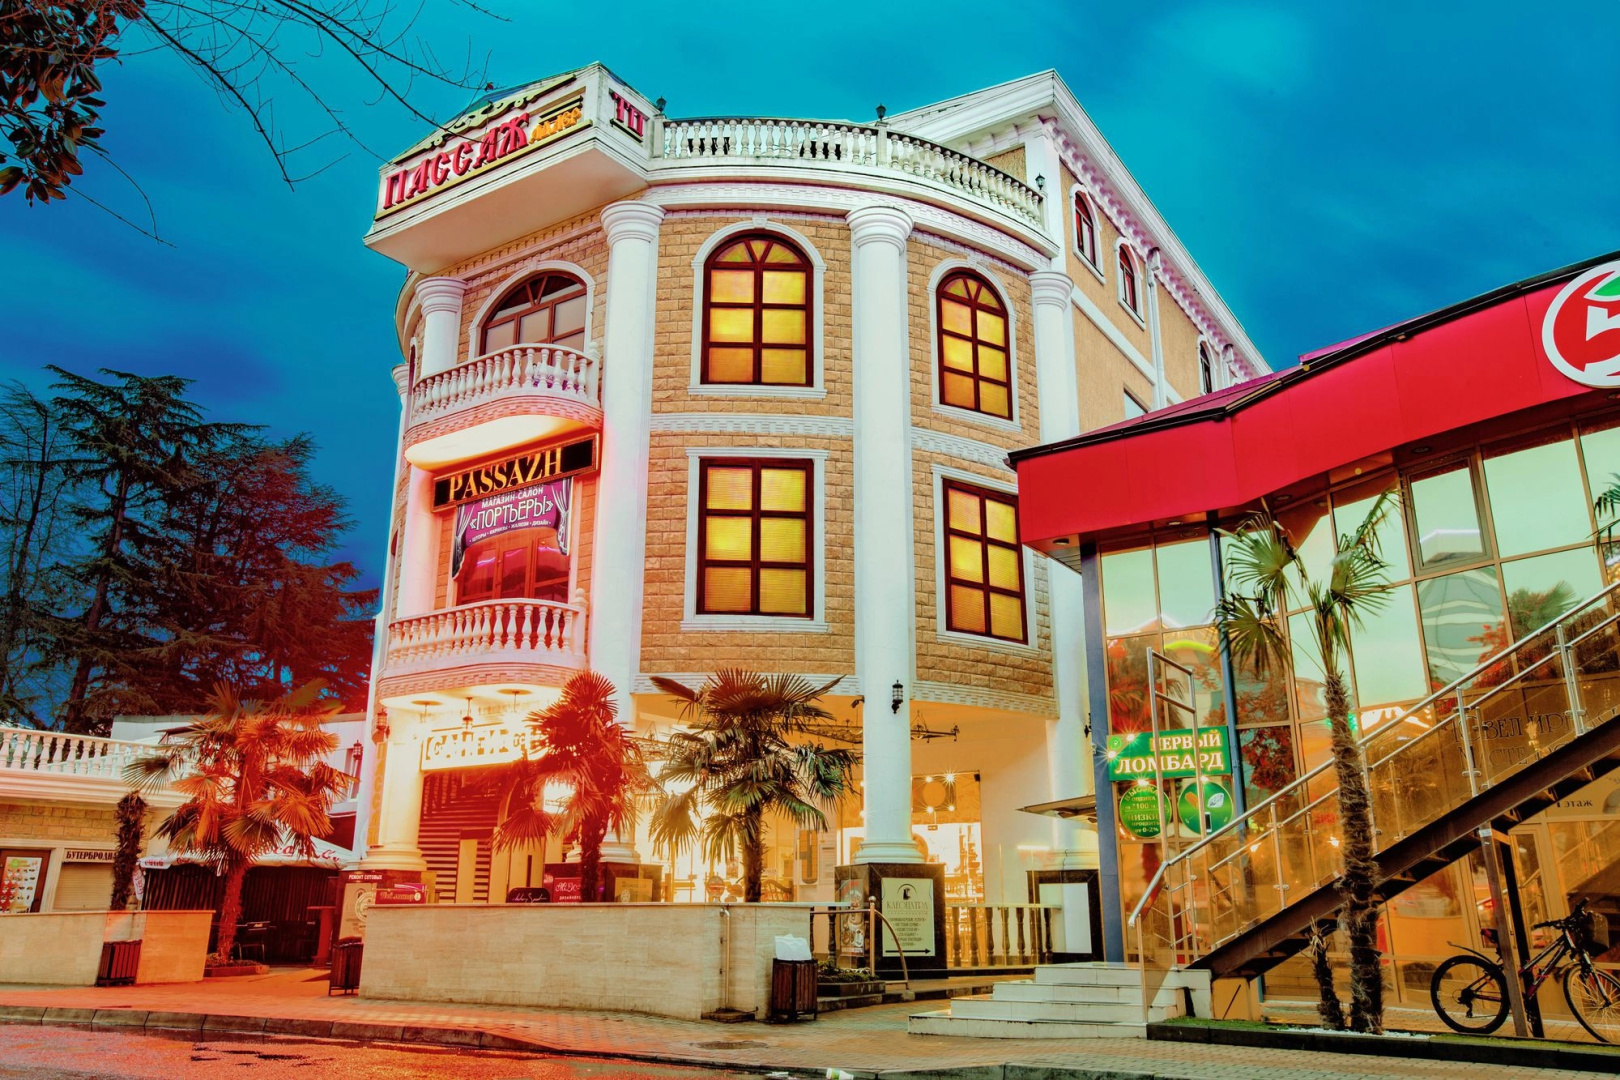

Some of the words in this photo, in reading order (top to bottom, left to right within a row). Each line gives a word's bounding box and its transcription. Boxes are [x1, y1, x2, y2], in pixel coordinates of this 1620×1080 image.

[383, 112, 530, 209] ПАССАЖ
[450, 447, 562, 500] PASSAZH
[481, 487, 544, 508] МАГАЗИН-САЛОН
[1115, 751, 1224, 774] ЛОМБАРД
[1564, 800, 1593, 808] этаж
